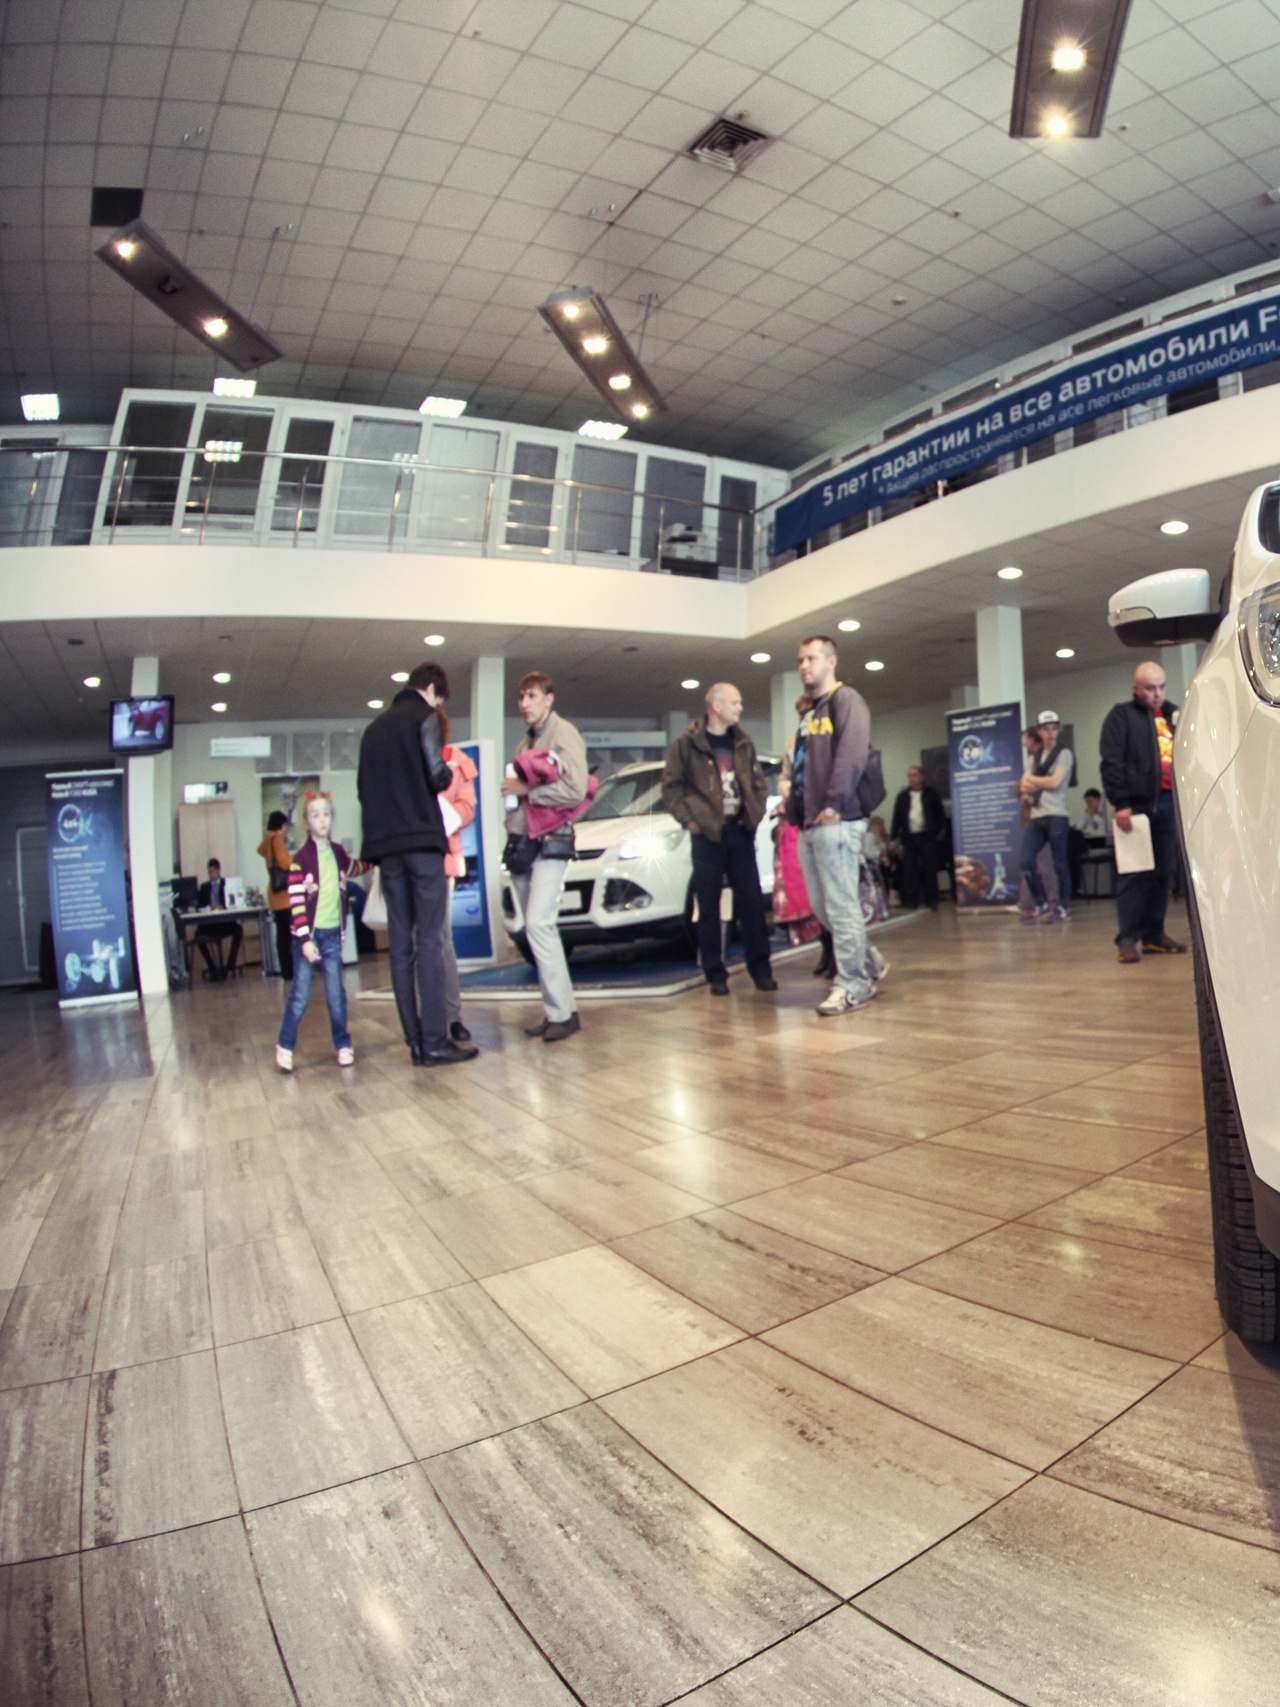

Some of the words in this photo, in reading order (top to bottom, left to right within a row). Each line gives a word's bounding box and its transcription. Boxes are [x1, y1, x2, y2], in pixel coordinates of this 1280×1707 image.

[822, 485, 834, 506] 5
[836, 470, 868, 499] лет
[872, 427, 971, 483] гарантии
[976, 412, 1004, 438] на
[1009, 390, 1052, 423] все
[1059, 320, 1250, 402] автомобили
[1037, 413, 1055, 430] на
[1087, 371, 1163, 412] легковые
